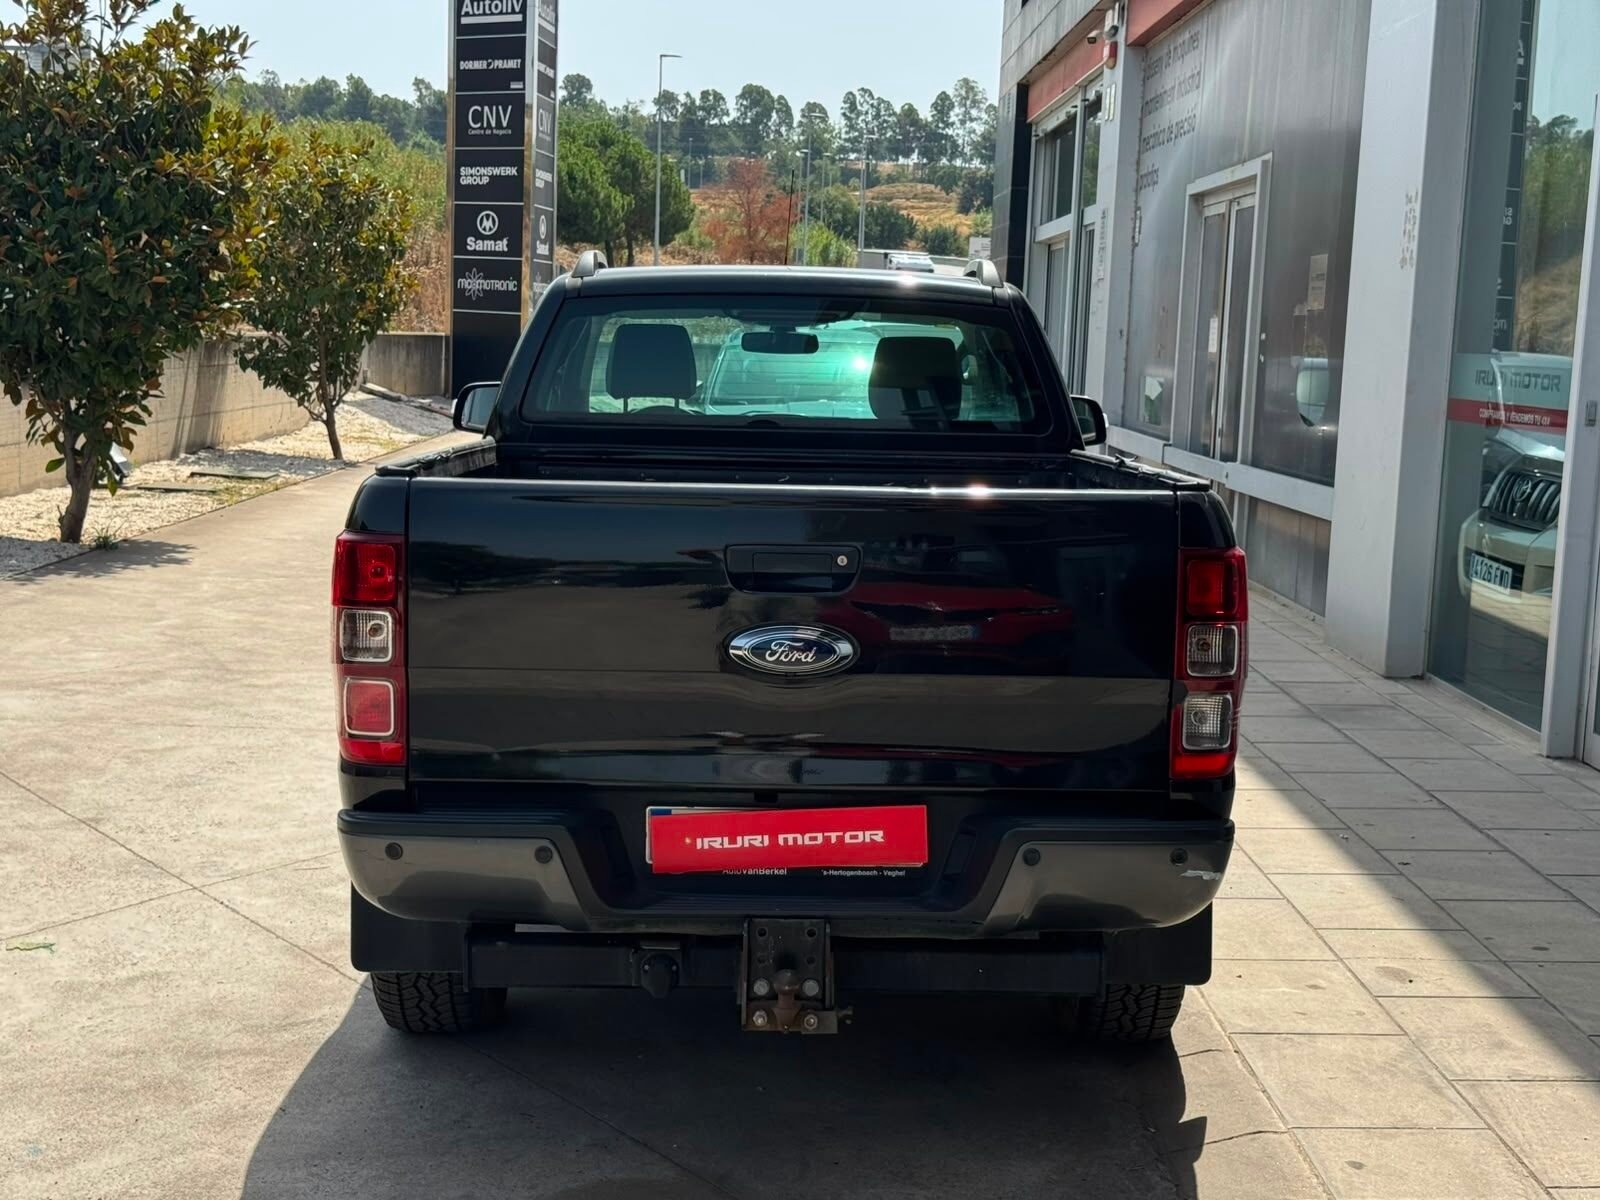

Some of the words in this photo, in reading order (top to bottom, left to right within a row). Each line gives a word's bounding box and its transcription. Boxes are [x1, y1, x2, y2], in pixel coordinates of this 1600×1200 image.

[460, 60, 487, 70] DORMER
[494, 59, 521, 69] PRAMET
[468, 105, 512, 128] CNV
[460, 167, 517, 176] SIMONSWERK
[460, 176, 489, 185] GROUP
[466, 236, 509, 252] Samat
[1510, 372, 1561, 393] MOTOR
[765, 640, 817, 663] Ford
[696, 835, 769, 849] IRURI
[778, 830, 884, 846] MOTOR
